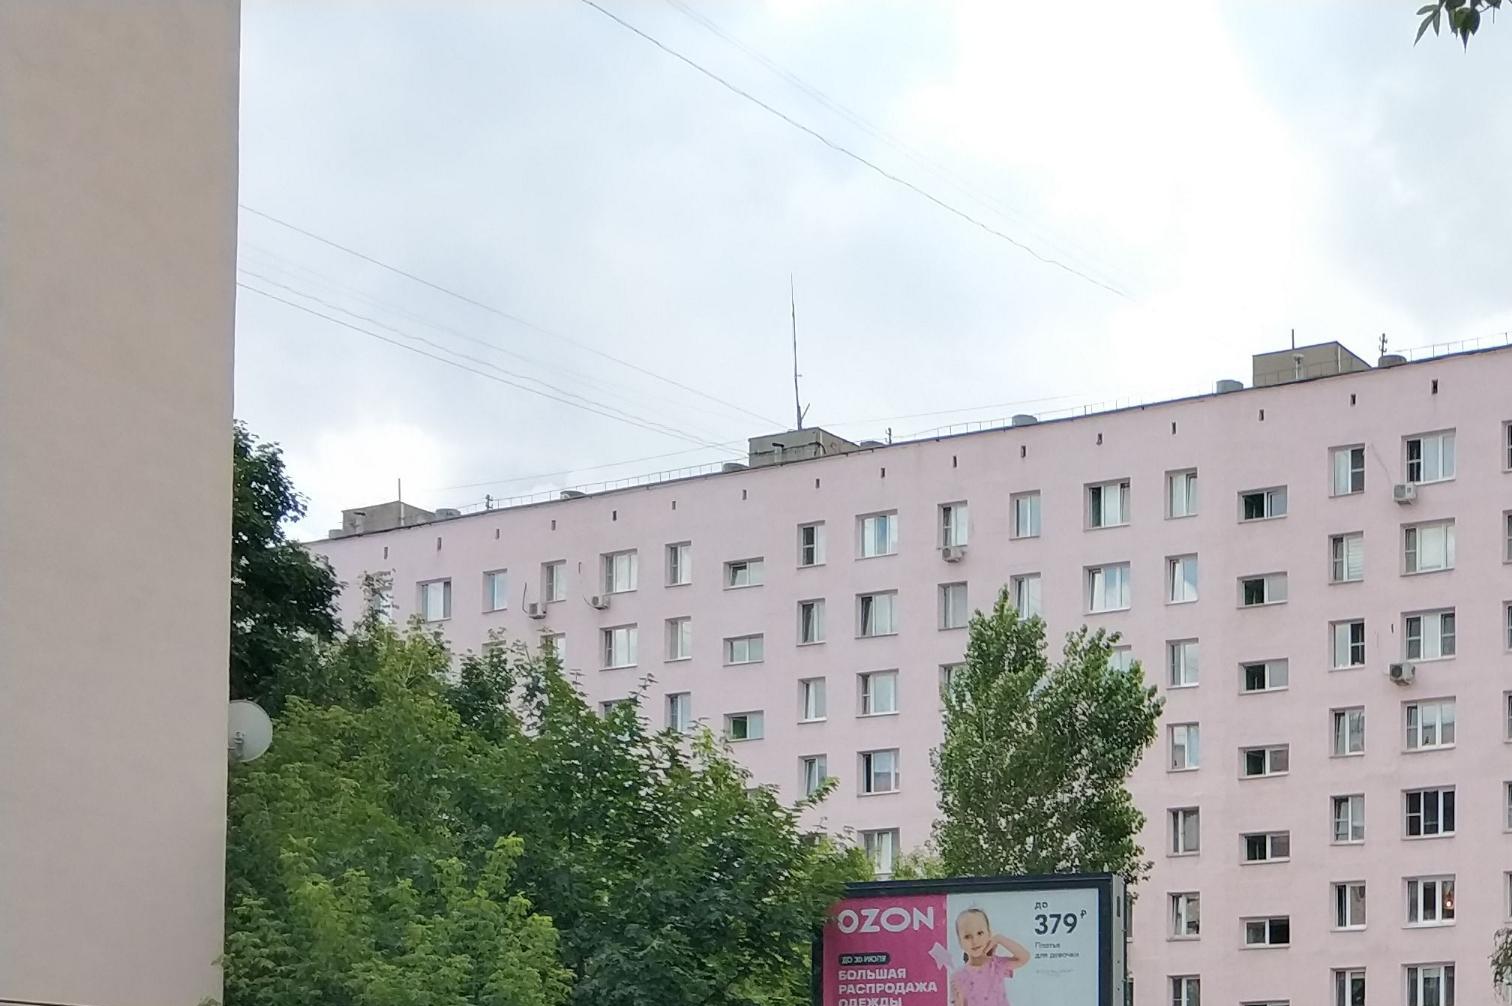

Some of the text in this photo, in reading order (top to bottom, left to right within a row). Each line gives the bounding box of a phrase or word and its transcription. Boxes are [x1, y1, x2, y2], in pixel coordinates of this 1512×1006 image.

[1034, 901, 1048, 910] до
[838, 906, 934, 933] OZON
[1034, 912, 1078, 935] 379
[838, 968, 906, 980] БОЛЬШАЯ
[838, 981, 938, 995] РАСПРОДАЖА
